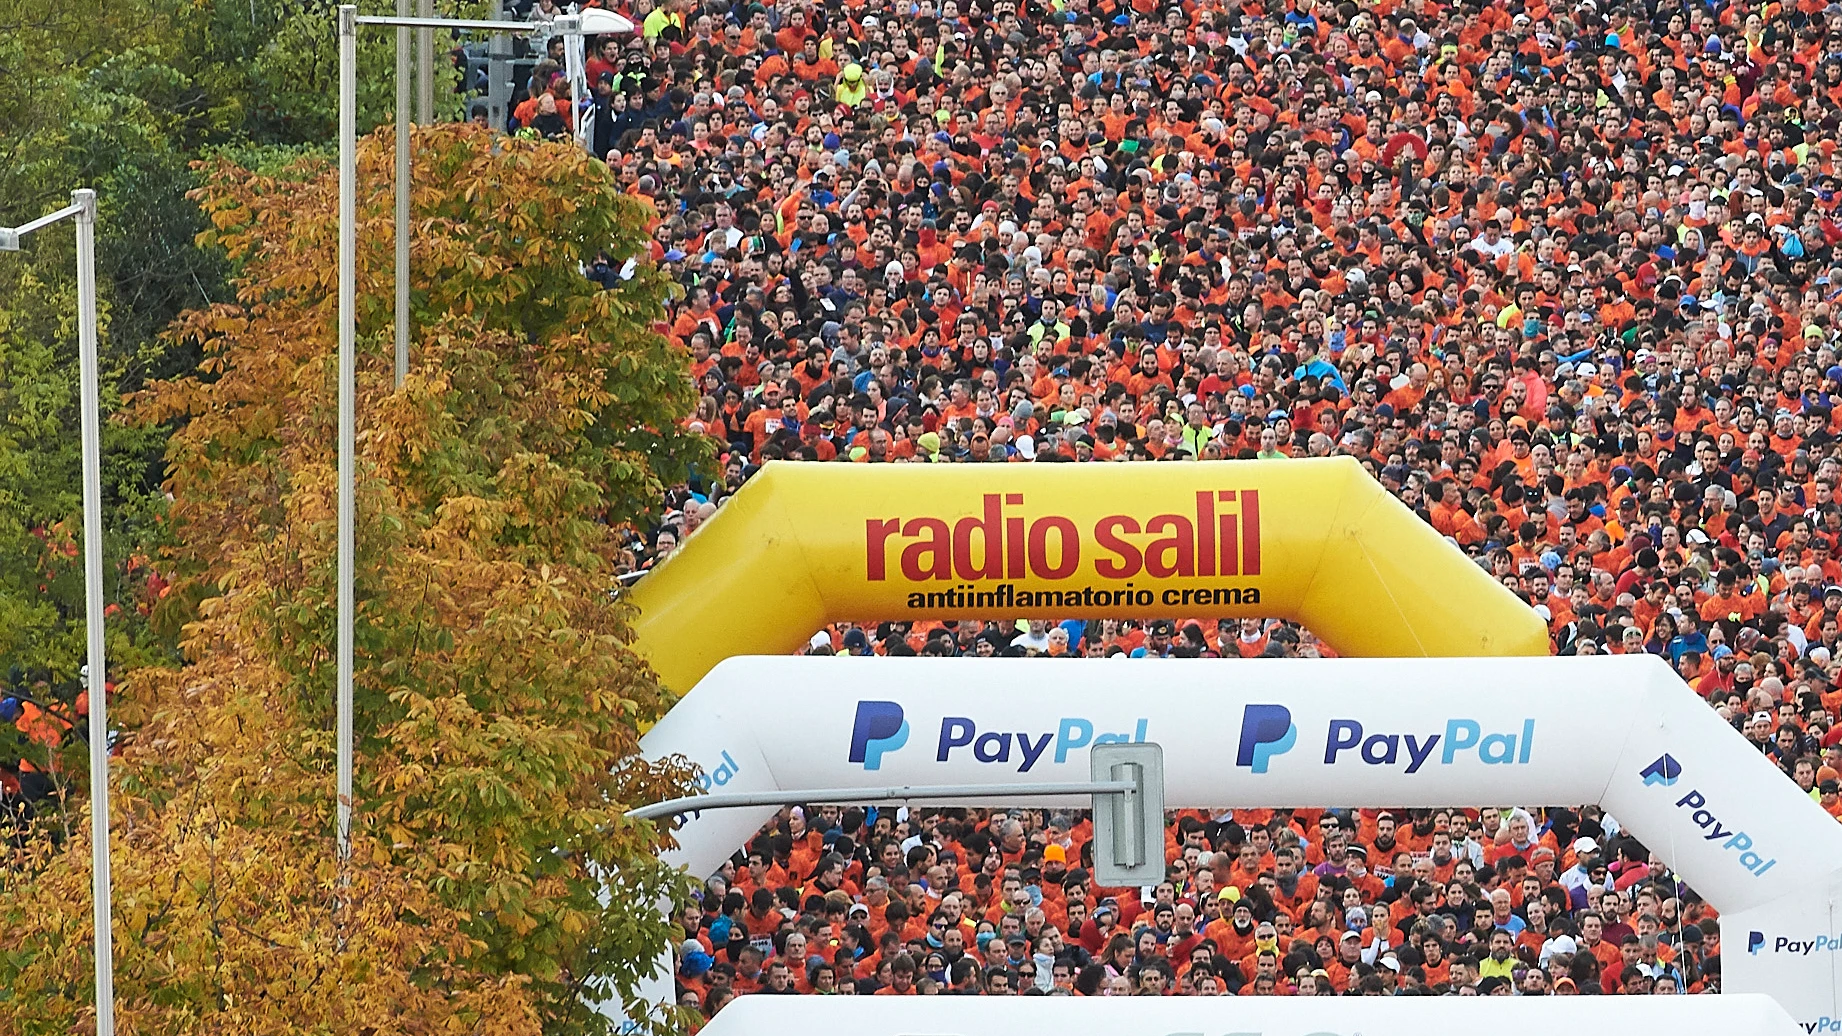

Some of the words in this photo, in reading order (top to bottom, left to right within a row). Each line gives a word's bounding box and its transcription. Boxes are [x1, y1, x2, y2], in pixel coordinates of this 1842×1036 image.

[866, 494, 1079, 581] radio
[1094, 489, 1261, 578] salil
[907, 581, 1155, 610] antiinflamatorio
[1161, 584, 1261, 607] crema
[936, 716, 1148, 772] PayPl
[1324, 718, 1535, 774] PayPal
[1676, 788, 1777, 878] PayPal
